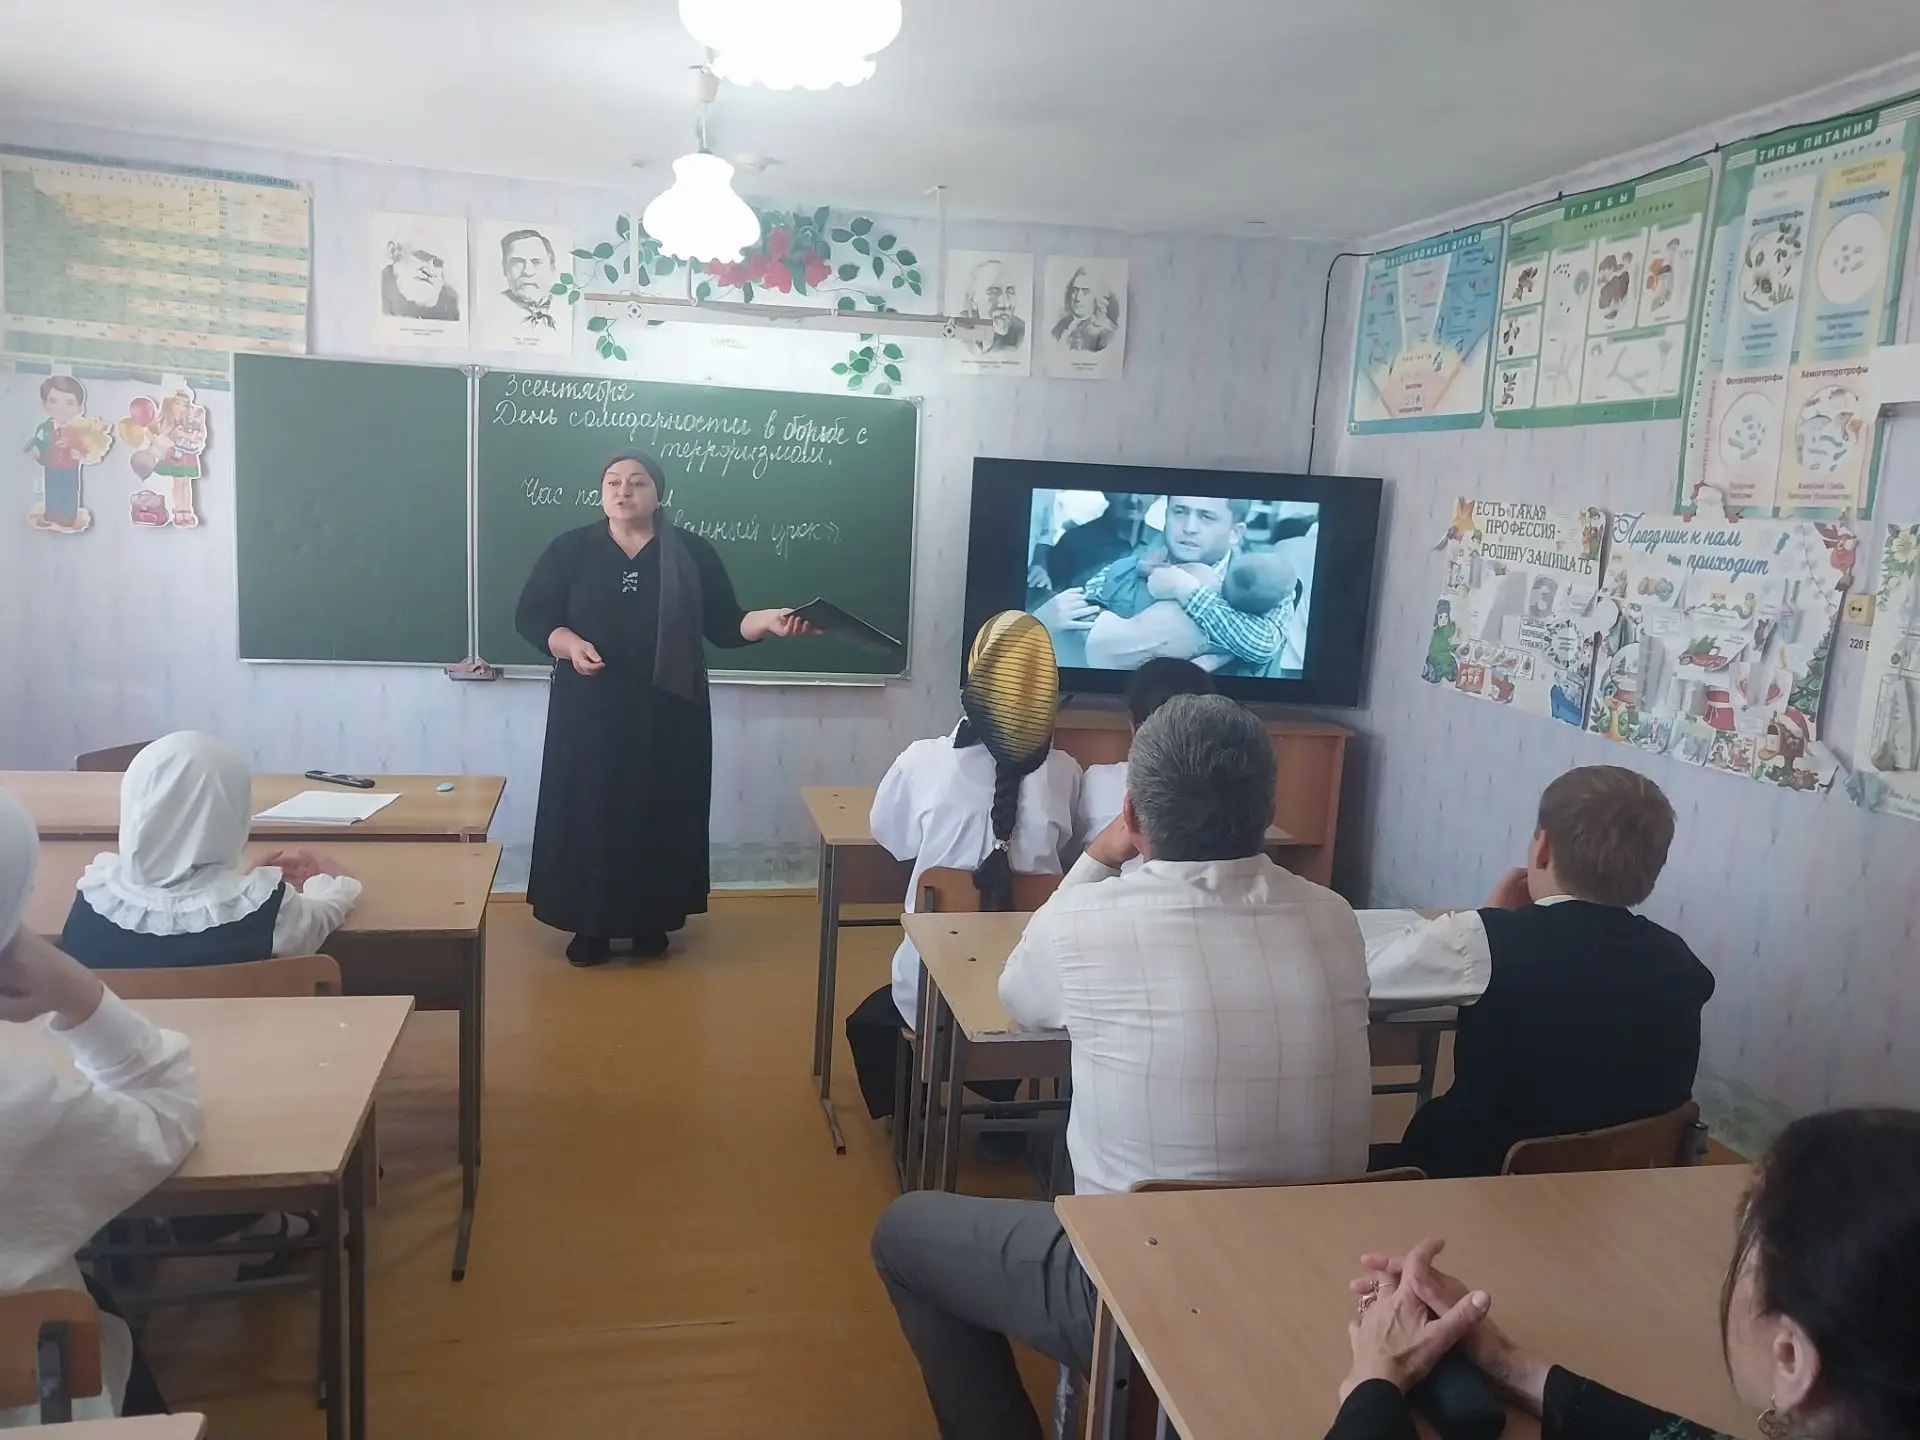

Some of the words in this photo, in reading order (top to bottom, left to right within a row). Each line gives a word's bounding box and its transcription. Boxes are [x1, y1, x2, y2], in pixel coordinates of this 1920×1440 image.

[1759, 141, 1797, 162] ТИПЫ
[1803, 119, 1873, 149] ПИТАНИЯ
[1570, 192, 1628, 217] ГРИБЫ
[505, 374, 518, 396] 3
[522, 378, 635, 412] сентября
[493, 399, 558, 426] День
[569, 409, 753, 446] солидарности
[764, 409, 779, 440] в
[783, 414, 850, 457] борьбе
[856, 427, 869, 444] с
[521, 477, 564, 506] Час
[1476, 501, 1506, 517] ЕСТЬ
[1510, 503, 1547, 520] ТАКАЯ
[1612, 512, 1689, 555] Праздник
[1690, 530, 1702, 544] к
[1703, 529, 1742, 547] нам
[1481, 542, 1528, 562] РОДИНУ
[1526, 548, 1593, 575] ЗАЩИЩАТЬ
[1686, 554, 1769, 583] приходит
[1849, 638, 1864, 650] 220
